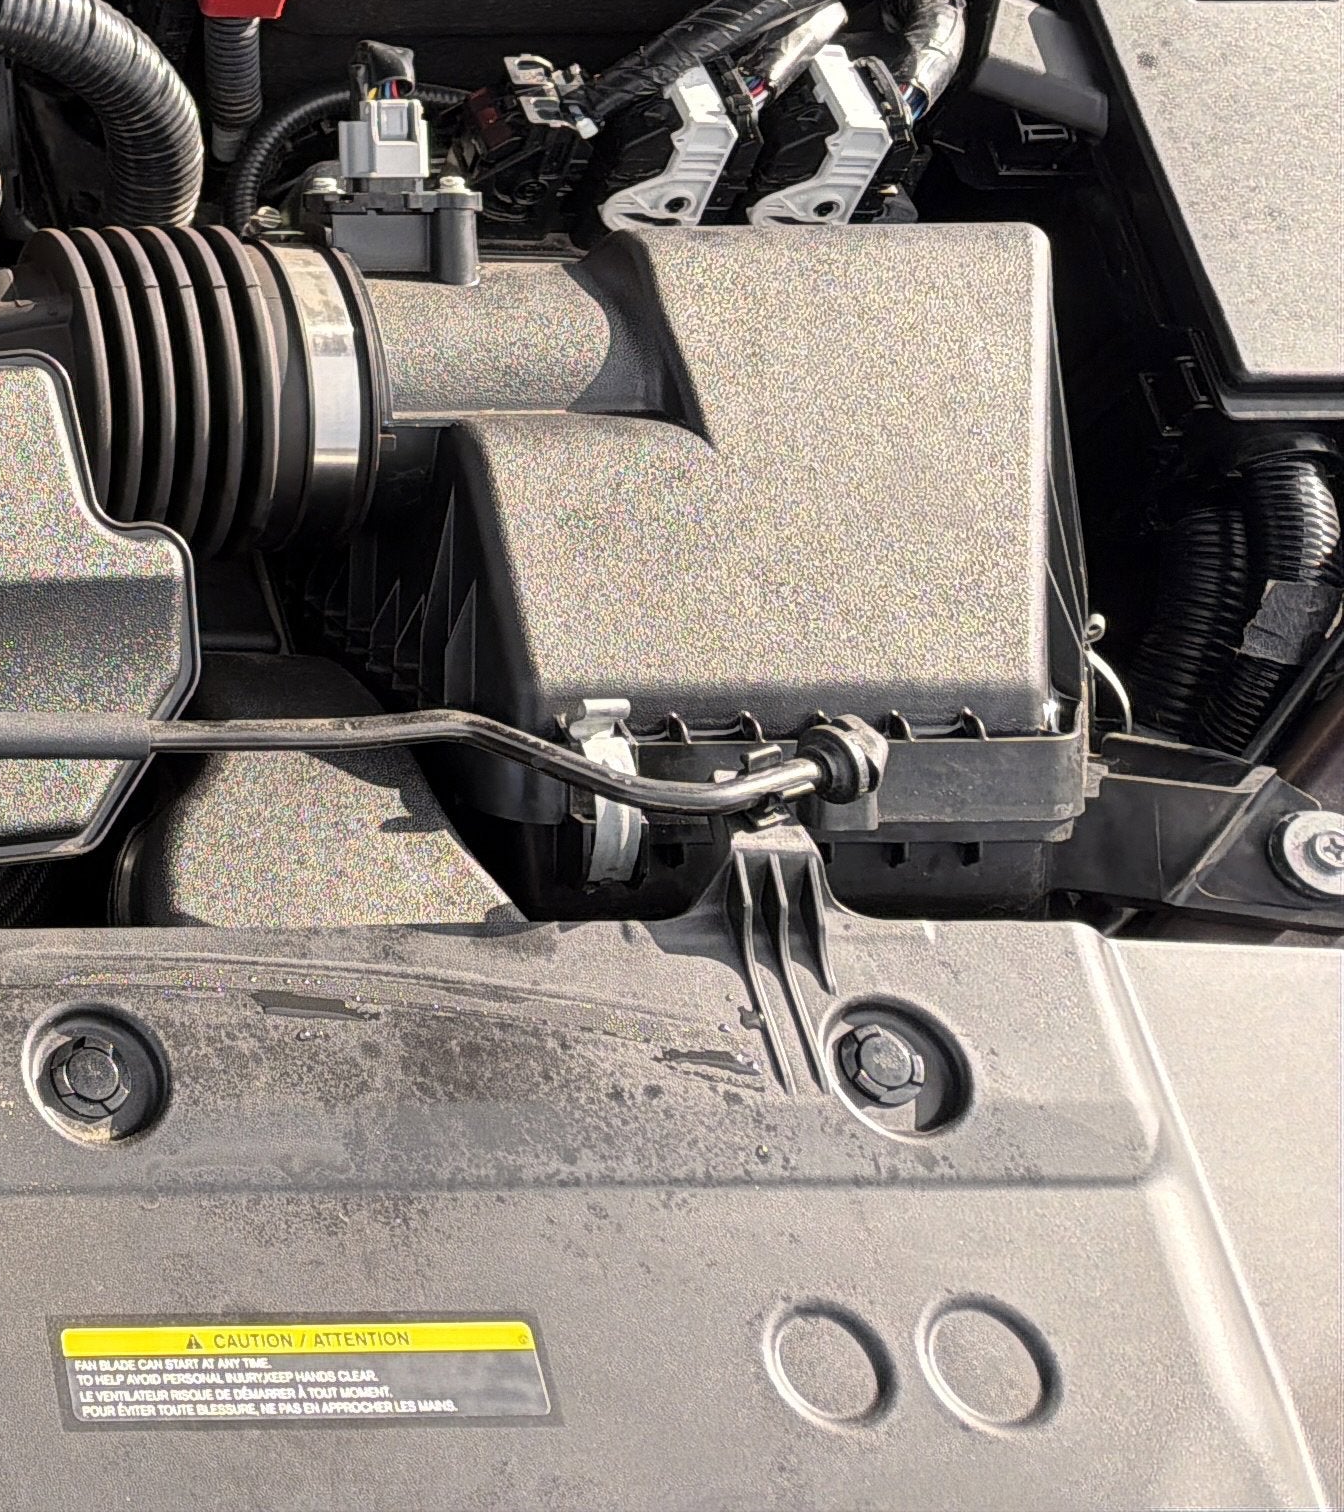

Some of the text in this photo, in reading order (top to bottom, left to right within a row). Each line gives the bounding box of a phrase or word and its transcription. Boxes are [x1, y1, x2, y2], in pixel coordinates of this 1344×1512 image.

[213, 1333, 293, 1349] CAUTION
[314, 1331, 410, 1348] ATTENTION
[75, 1357, 272, 1371] FAN BLADE CAN START AT ANY TIME.
[76, 1374, 93, 1386] TO
[95, 1374, 124, 1386] HELP
[126, 1373, 161, 1385] AVOID
[163, 1373, 224, 1385] PERSONAL
[295, 1370, 336, 1382] HANDS
[337, 1369, 379, 1382] CLEAR.
[80, 1384, 393, 1402] LE VENTILATEUR RISQUE DE DÉMARRER À TOUT MOMENT.
[82, 1399, 458, 1418] POUR ÉVITER TOUTE BLESSURE, NE PAS EN APPROCHER LES MAINS.
